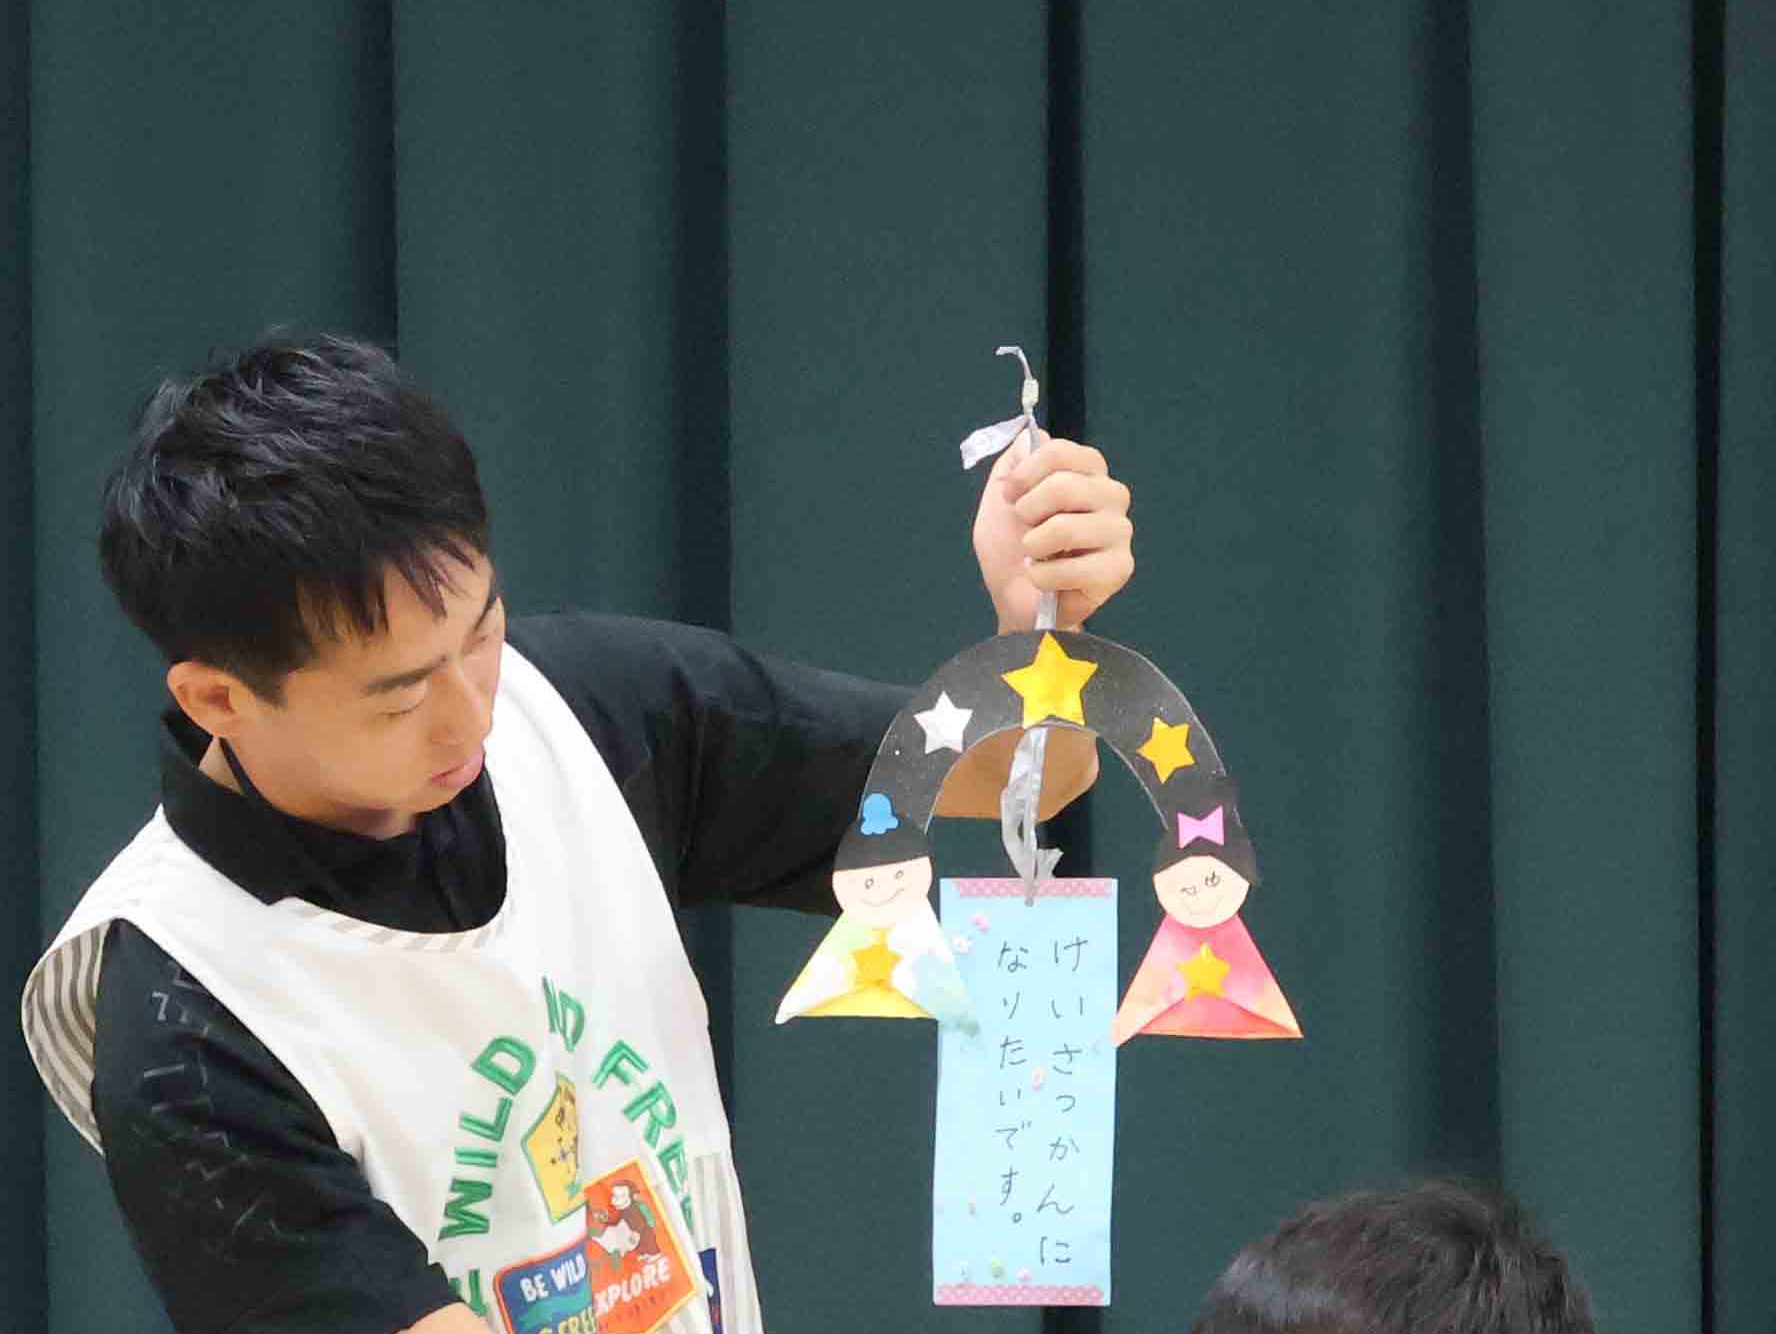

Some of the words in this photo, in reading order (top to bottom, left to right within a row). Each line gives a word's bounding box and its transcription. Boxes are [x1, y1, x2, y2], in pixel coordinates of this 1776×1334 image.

[438, 1034, 537, 1242] WILD
[994, 943, 1033, 1225] なりたいです。
[519, 1274, 549, 1304] BE
